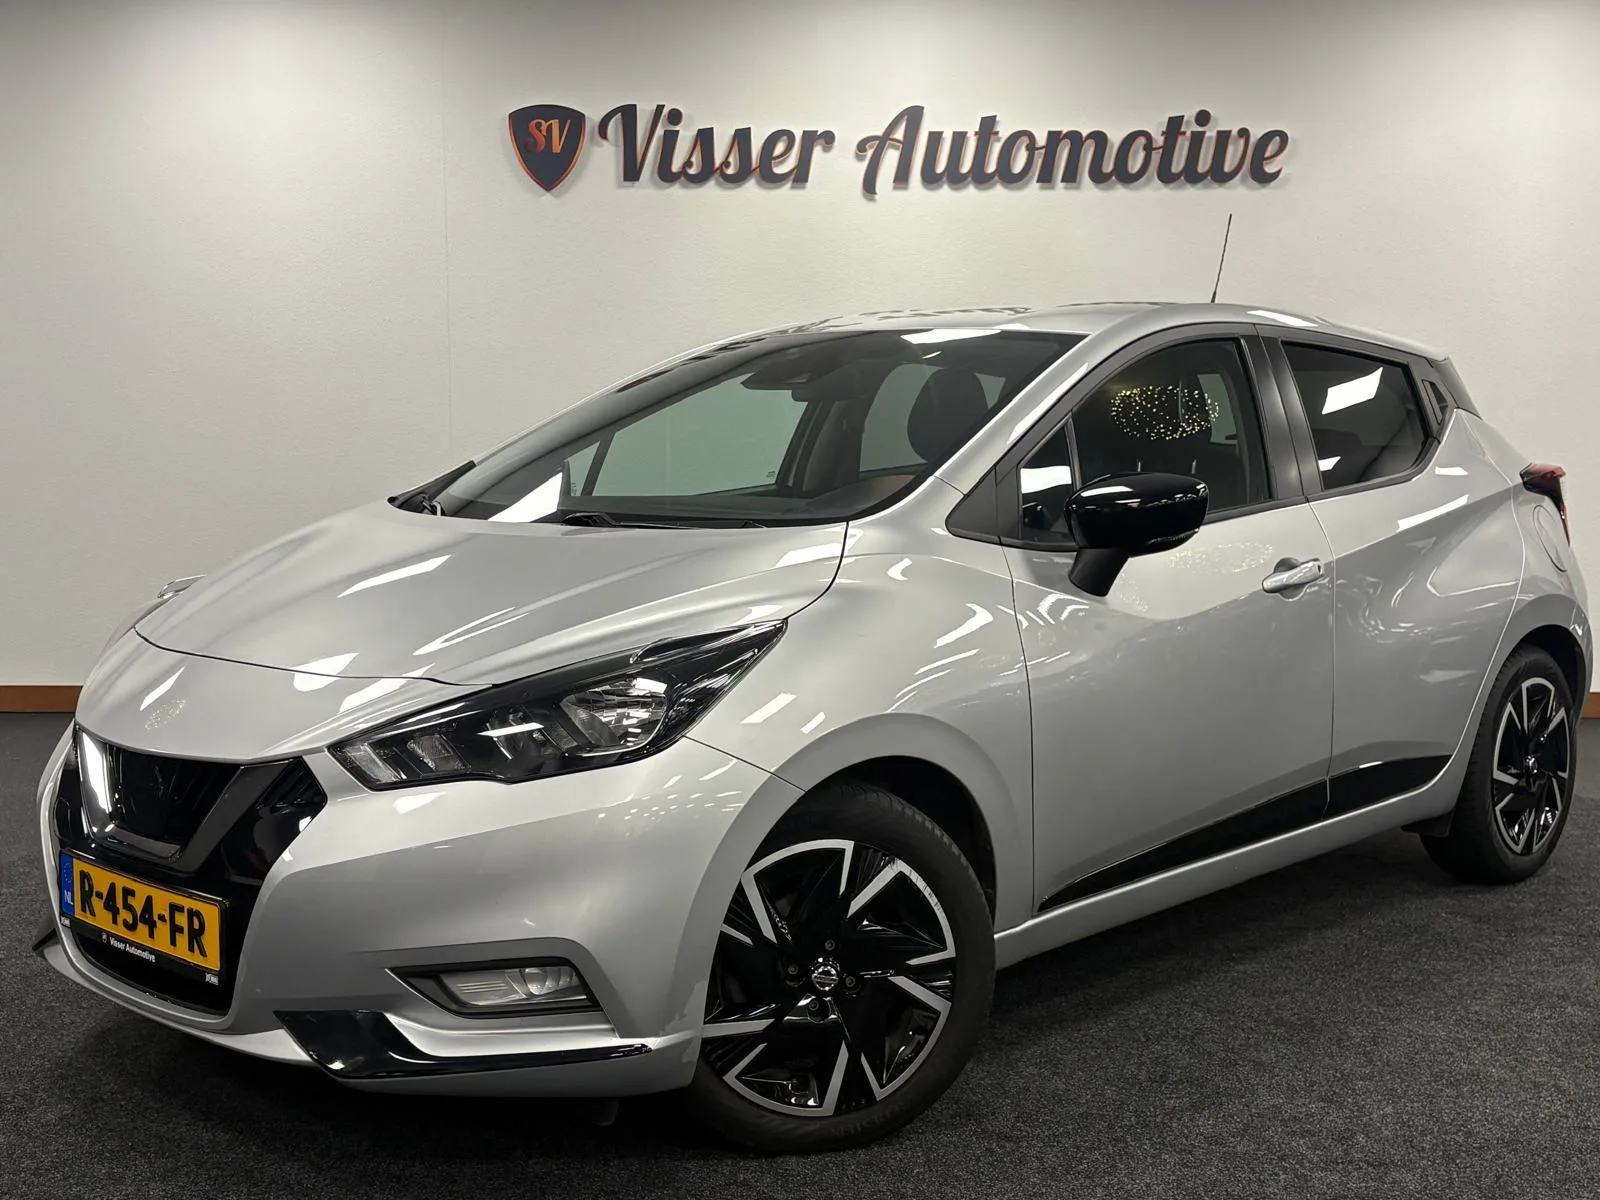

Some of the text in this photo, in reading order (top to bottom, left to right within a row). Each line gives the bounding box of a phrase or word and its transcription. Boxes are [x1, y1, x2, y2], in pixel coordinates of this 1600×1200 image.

[598, 103, 1289, 195] Visser Automotive
[64, 889, 74, 906] NL
[79, 869, 208, 958] R-454-FR
[110, 936, 156, 963] Visser Automotive
